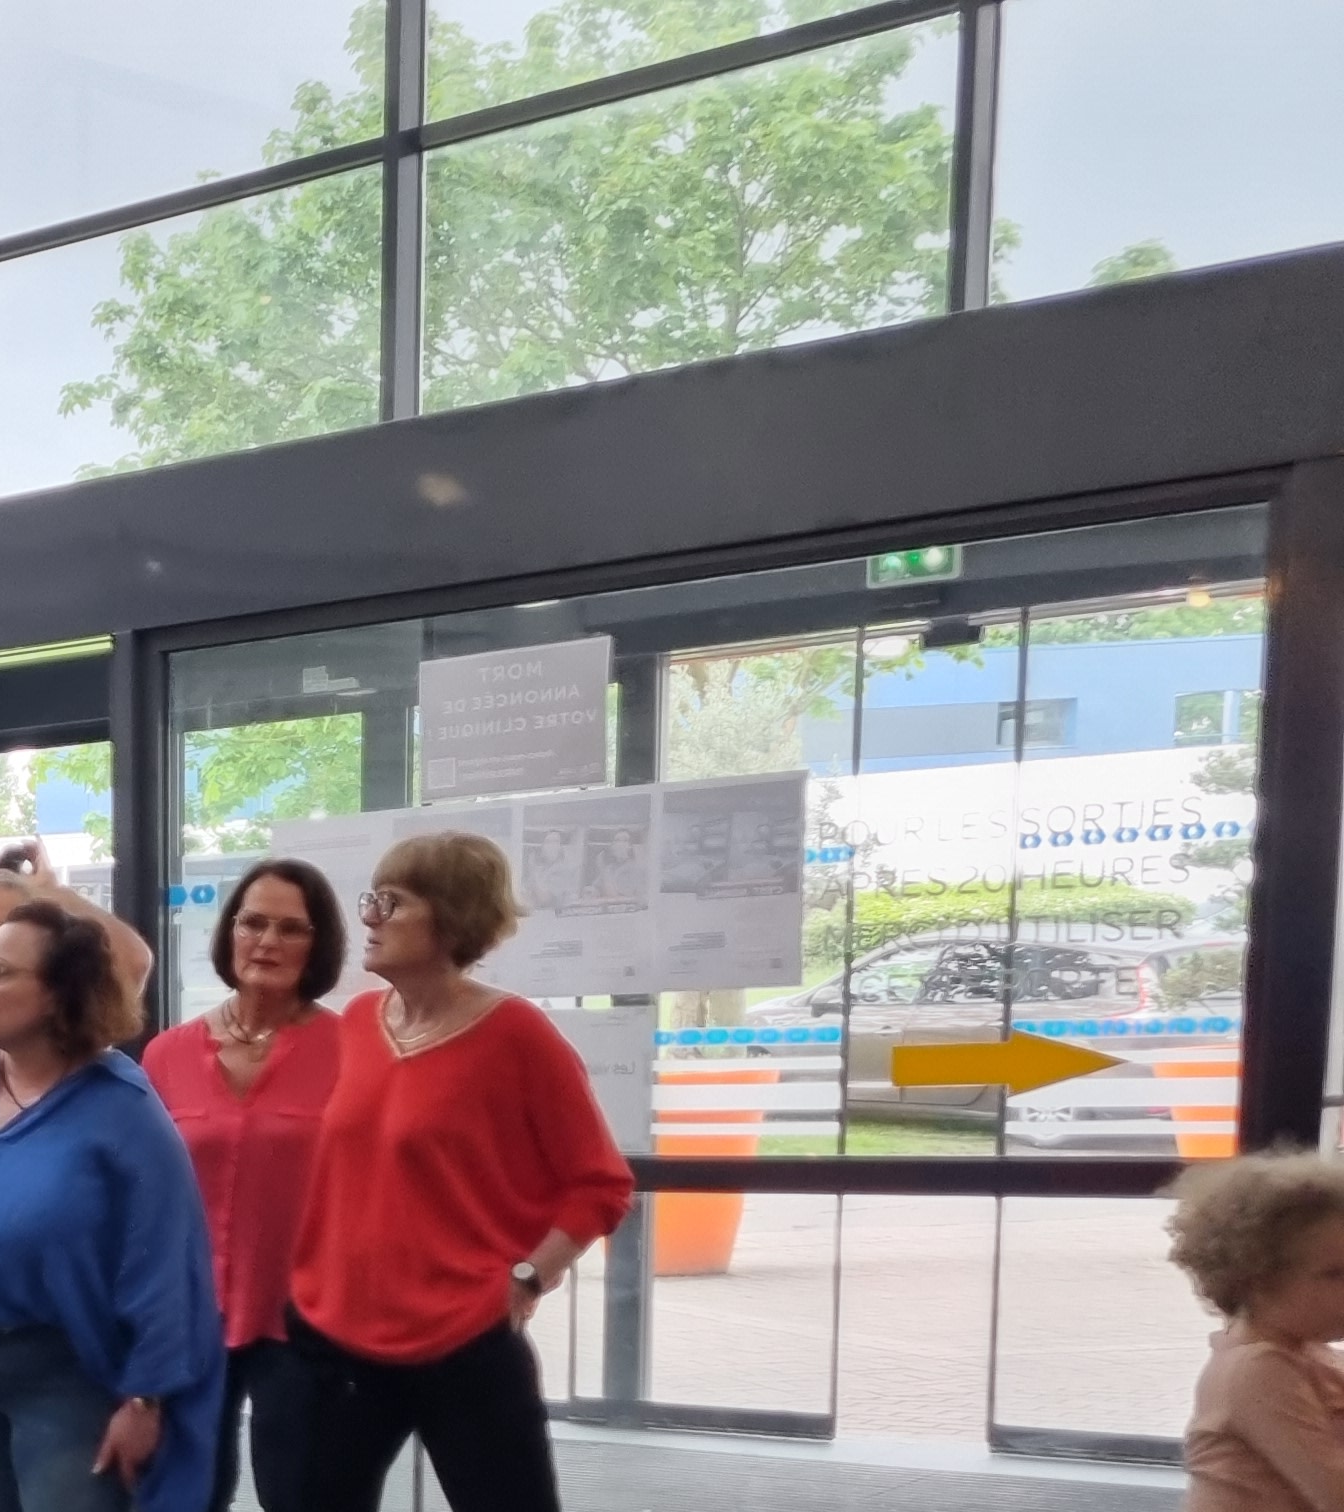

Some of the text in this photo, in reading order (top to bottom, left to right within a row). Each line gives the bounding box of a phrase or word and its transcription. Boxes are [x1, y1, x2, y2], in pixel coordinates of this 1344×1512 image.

[818, 795, 1202, 848] POUR LES SORTIES
[957, 864, 1007, 895] 20
[1018, 852, 1190, 891] HEURES
